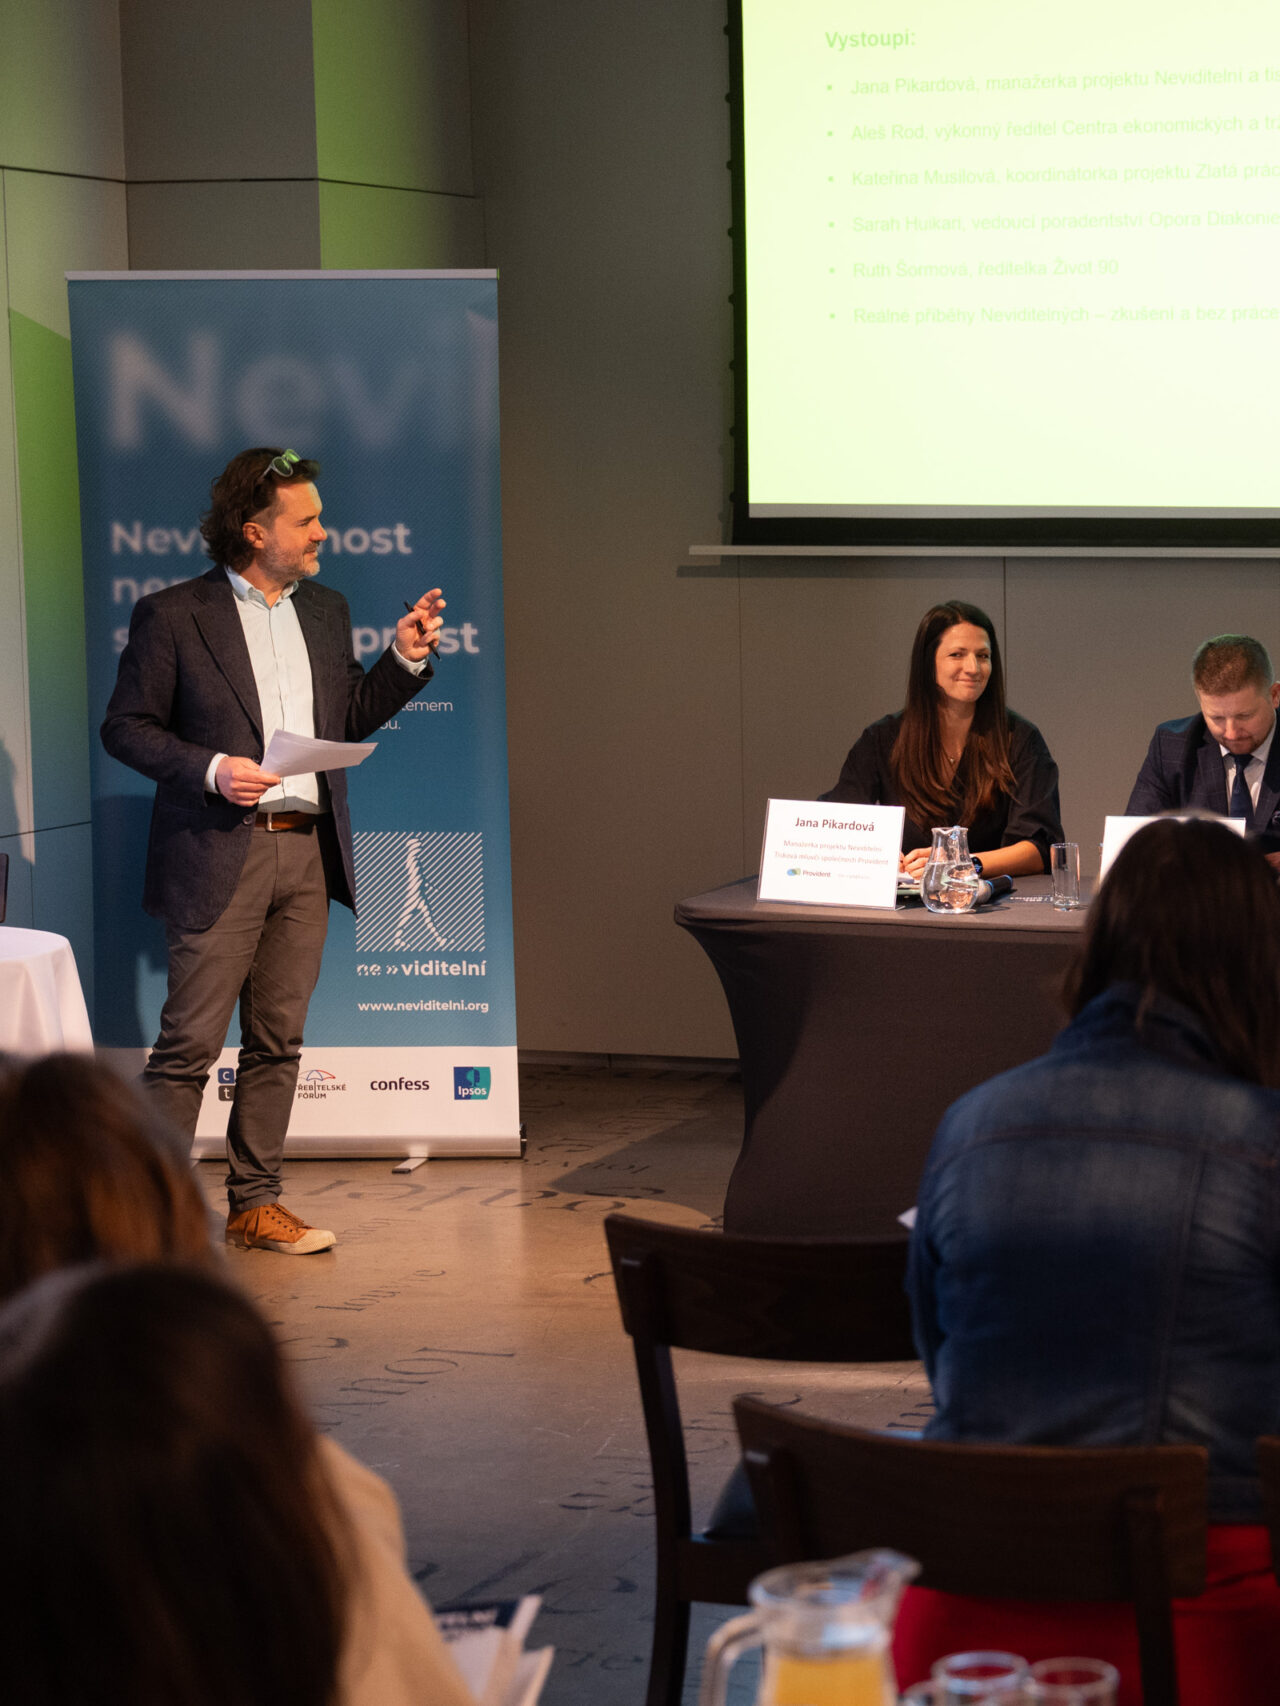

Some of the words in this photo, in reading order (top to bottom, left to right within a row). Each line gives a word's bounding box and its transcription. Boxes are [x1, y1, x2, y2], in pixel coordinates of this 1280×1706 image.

[795, 817, 819, 829] Jana
[822, 819, 875, 832] Pikardová
[803, 869, 831, 878] Provident
[401, 959, 487, 976] viditelní
[357, 999, 489, 1013] www.neviditelni.org
[370, 1076, 430, 1091] confess
[458, 1085, 488, 1098] Ipsos
